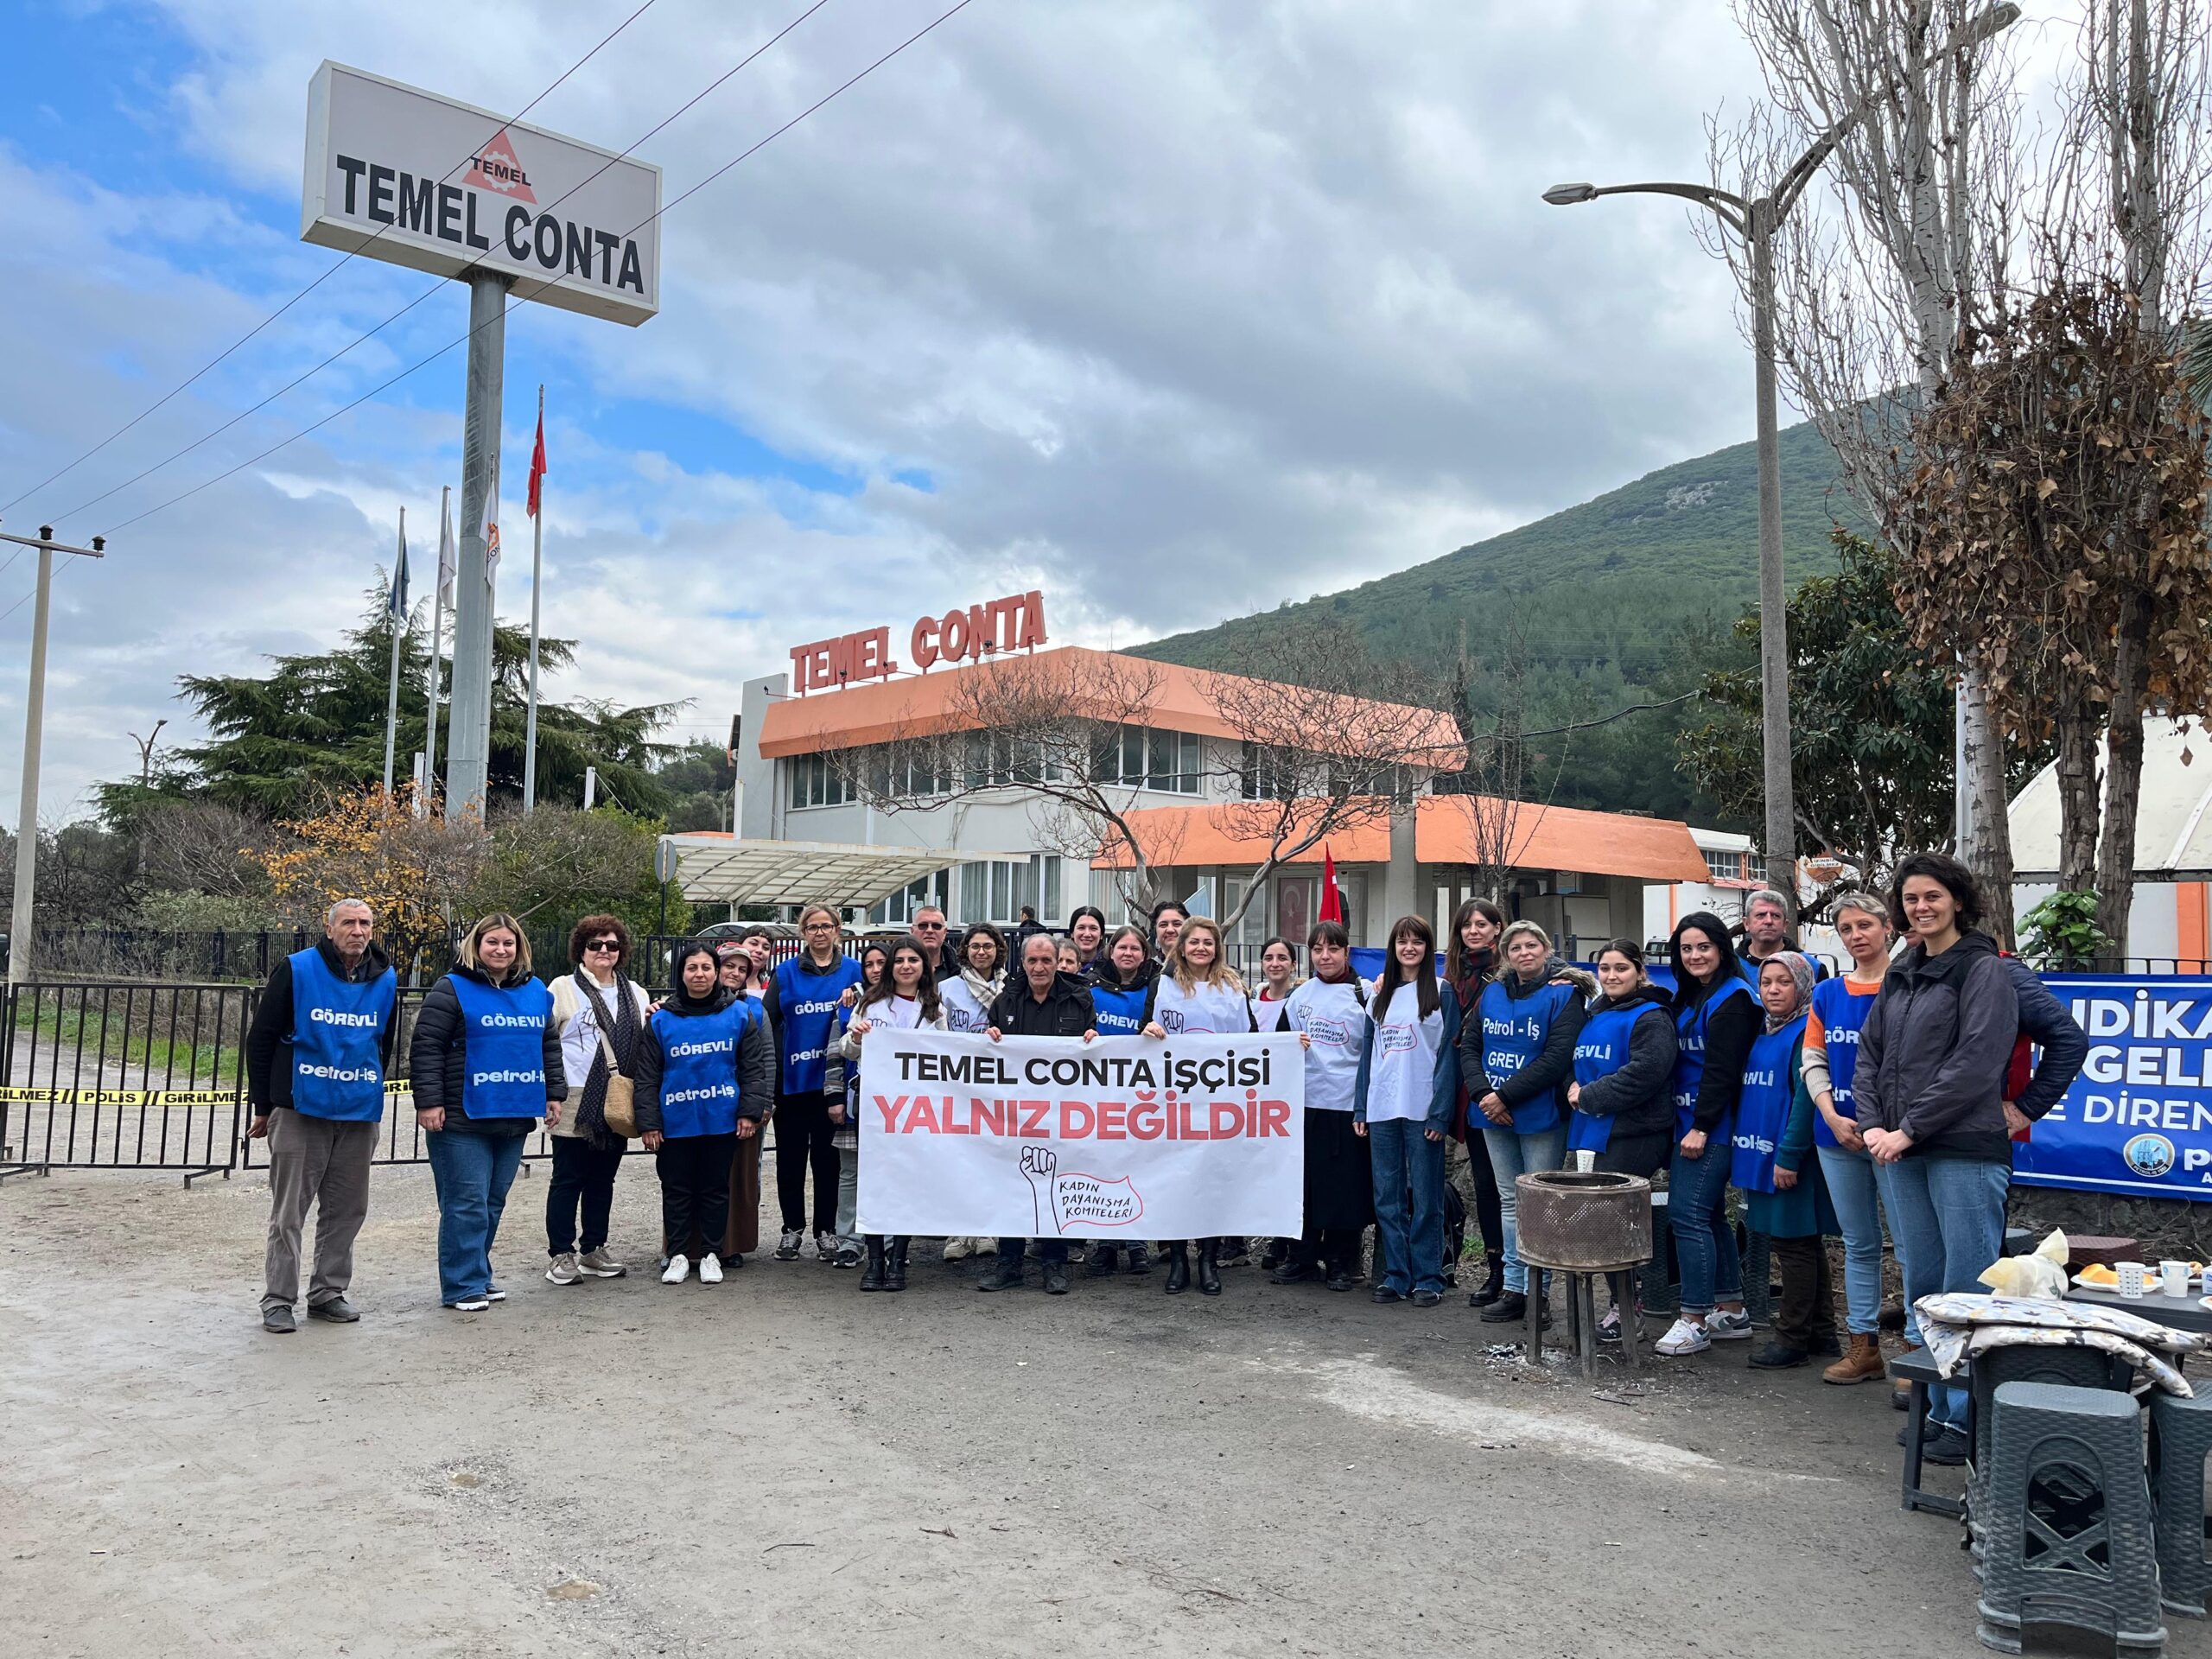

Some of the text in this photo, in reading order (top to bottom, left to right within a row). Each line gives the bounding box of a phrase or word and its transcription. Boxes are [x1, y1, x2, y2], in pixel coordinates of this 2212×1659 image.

[470, 156, 532, 187] TEMEL
[337, 154, 645, 294] TEMEL CONTA
[790, 590, 1047, 692] TEMEL CONTA
[311, 1007, 378, 1027] GÖREVLİ
[1483, 1017, 1514, 1036] Petrol
[1527, 1016, 1541, 1040] İş
[670, 1037, 734, 1058] GÖREVLİ
[894, 1048, 1270, 1094] TEMEL CONTA İŞÇİSİ
[1488, 1051, 1526, 1070] GREV
[299, 1063, 378, 1084] petrol-iş
[473, 1069, 546, 1087] petrol-i
[665, 1084, 735, 1106] petrol-iş
[872, 1088, 1292, 1141] YALNIZ DEĞİLDİR
[1059, 1180, 1100, 1193] KADIN
[1062, 1193, 1131, 1208] DAYANIŞMA
